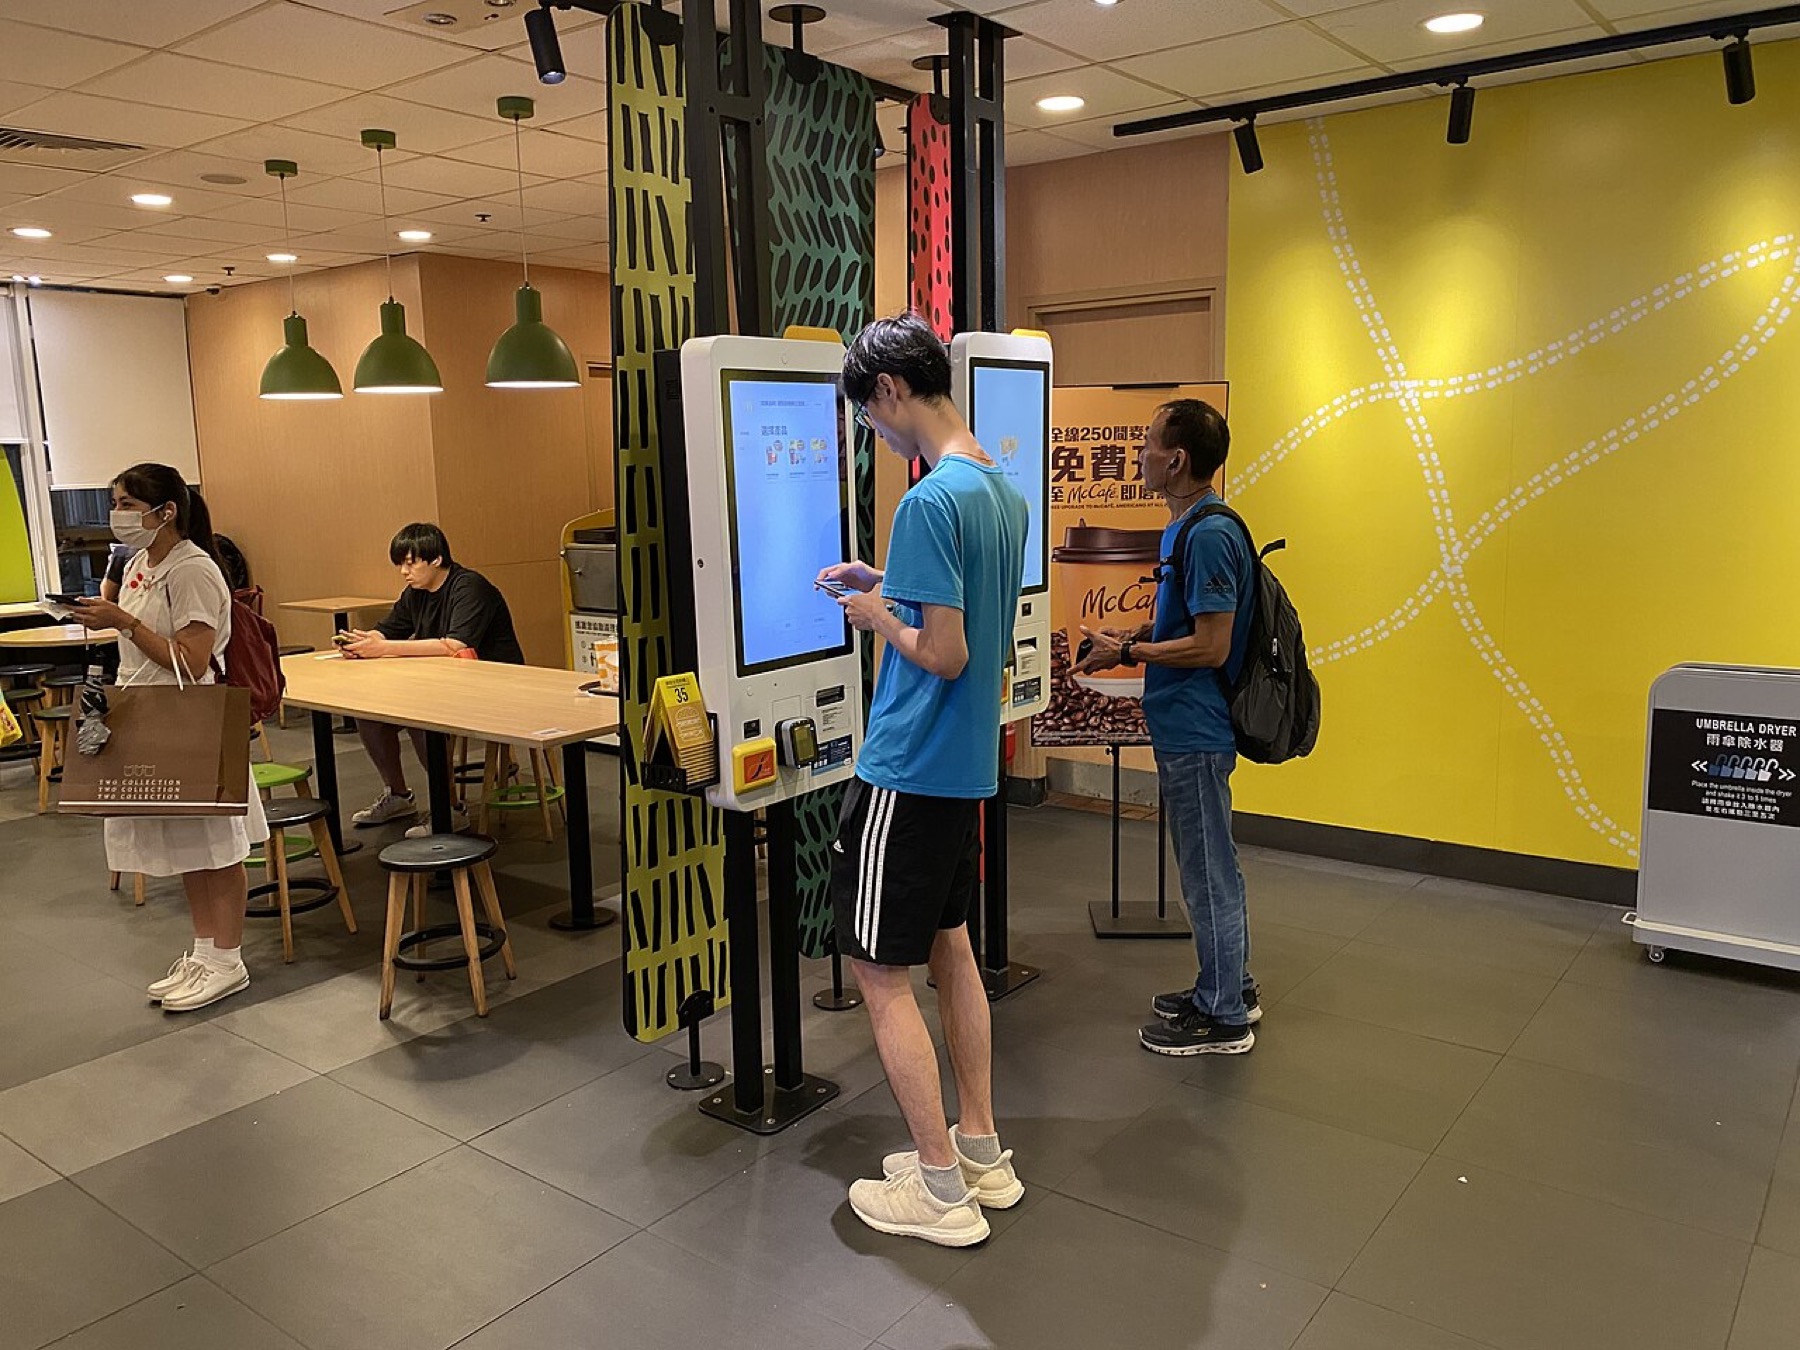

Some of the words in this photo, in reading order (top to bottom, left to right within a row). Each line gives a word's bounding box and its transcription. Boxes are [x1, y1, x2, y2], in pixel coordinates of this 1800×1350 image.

[1051, 486, 1064, 502] 至
[674, 687, 689, 704] 35
[1696, 718, 1755, 733] UMBRELLA
[1758, 723, 1797, 737] DRYER
[121, 785, 180, 793] COLLECTION
[122, 778, 181, 786] COLLECTION
[1691, 780, 1708, 788] Place
[1719, 783, 1745, 792] umbrella
[1746, 786, 1764, 794] inside
[1776, 789, 1793, 798] dryer
[1718, 791, 1735, 799] shake
[1760, 796, 1777, 804] times
